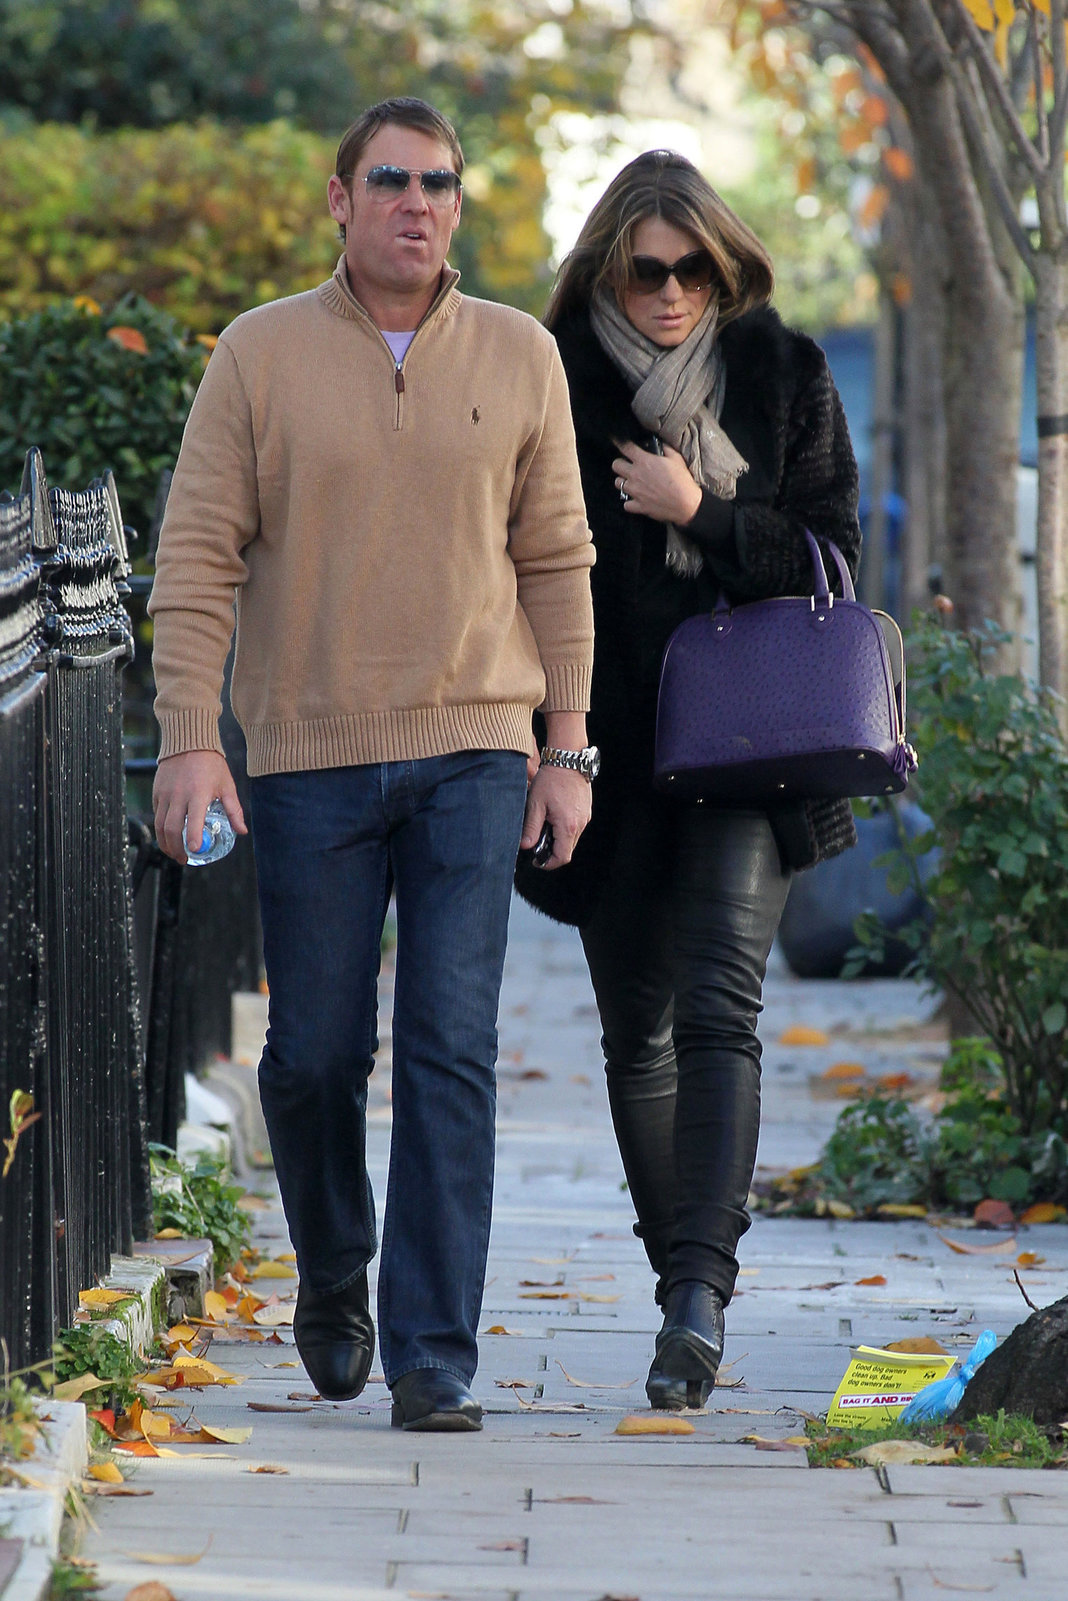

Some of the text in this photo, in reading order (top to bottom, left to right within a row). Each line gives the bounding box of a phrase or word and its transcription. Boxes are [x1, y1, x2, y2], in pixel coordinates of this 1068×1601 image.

[855, 1363, 907, 1375] Good dog owners
[851, 1371, 868, 1379] clean
[847, 1379, 860, 1387] dog
[860, 1380, 882, 1388] owners
[871, 1396, 899, 1405] AND
